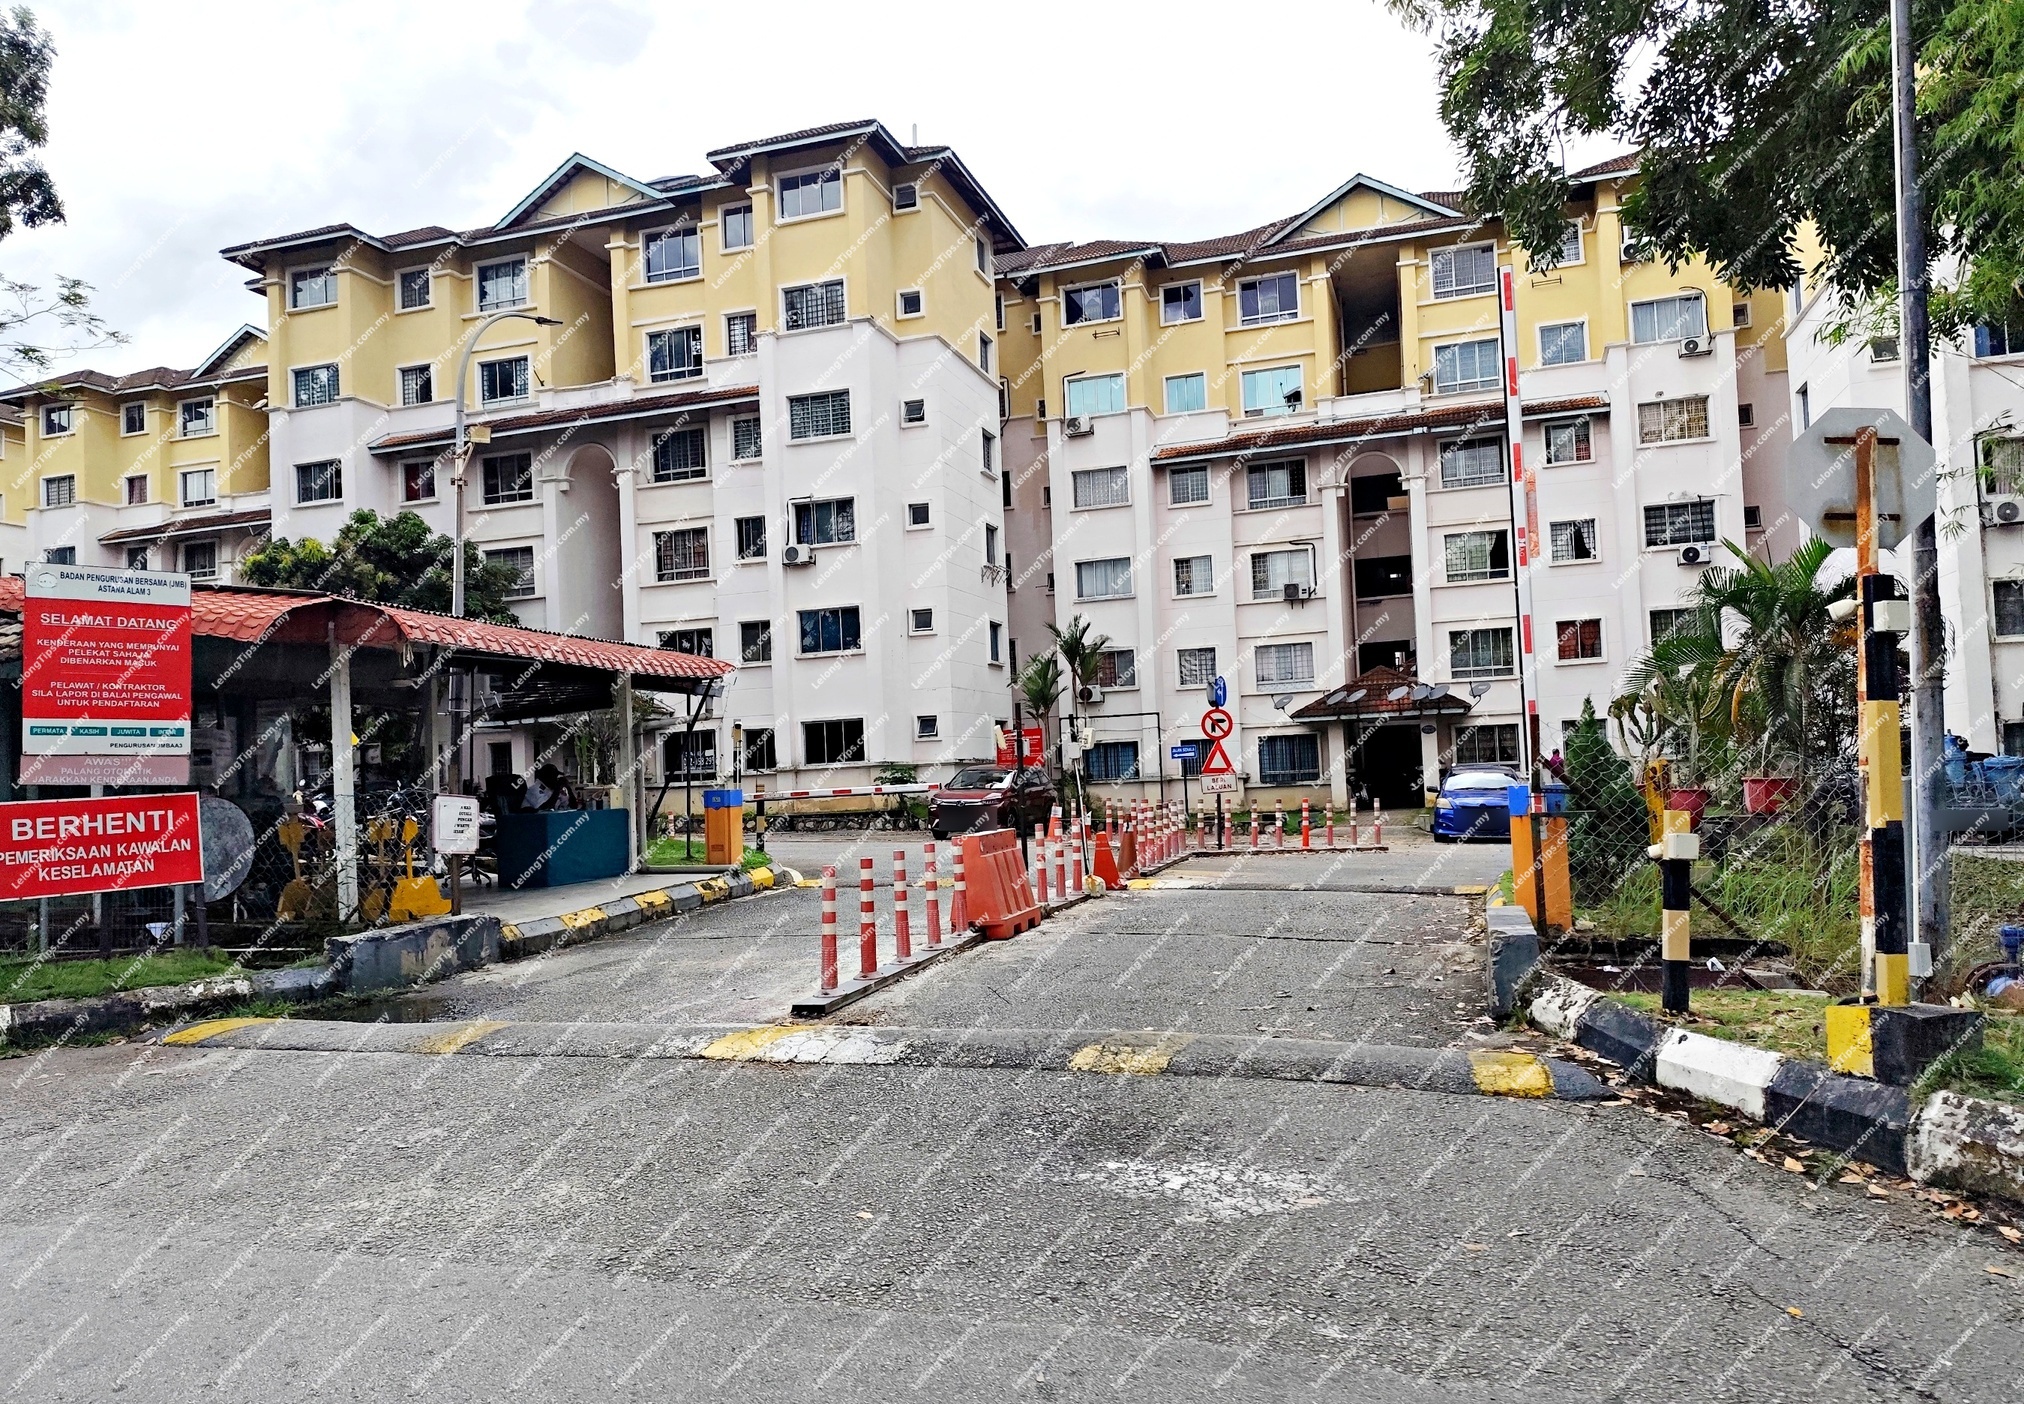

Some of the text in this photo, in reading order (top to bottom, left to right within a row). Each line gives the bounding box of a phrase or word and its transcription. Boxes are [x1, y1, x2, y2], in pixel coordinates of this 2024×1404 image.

[60, 571, 187, 589] BADAN PENGURUSAN BERSAMA (JMB)
[98, 585, 151, 596] ASTANA ALAM 3
[41, 613, 176, 630] SELAMAT DATANG
[37, 639, 96, 648] KENDERAAN
[126, 643, 179, 651] MEMPUNYAI
[69, 649, 110, 657] PELEKAT
[60, 657, 157, 667] DIBENARKAN MASUK
[51, 682, 94, 690] PELAWAT
[102, 683, 165, 691] KONTRAKTOR
[92, 700, 160, 708] PENDAFTARAN
[11, 810, 173, 841] BERHENTI
[0, 838, 191, 865] PEMERIKSAAN KAWALAN
[38, 859, 155, 881] KESELAMATAN
